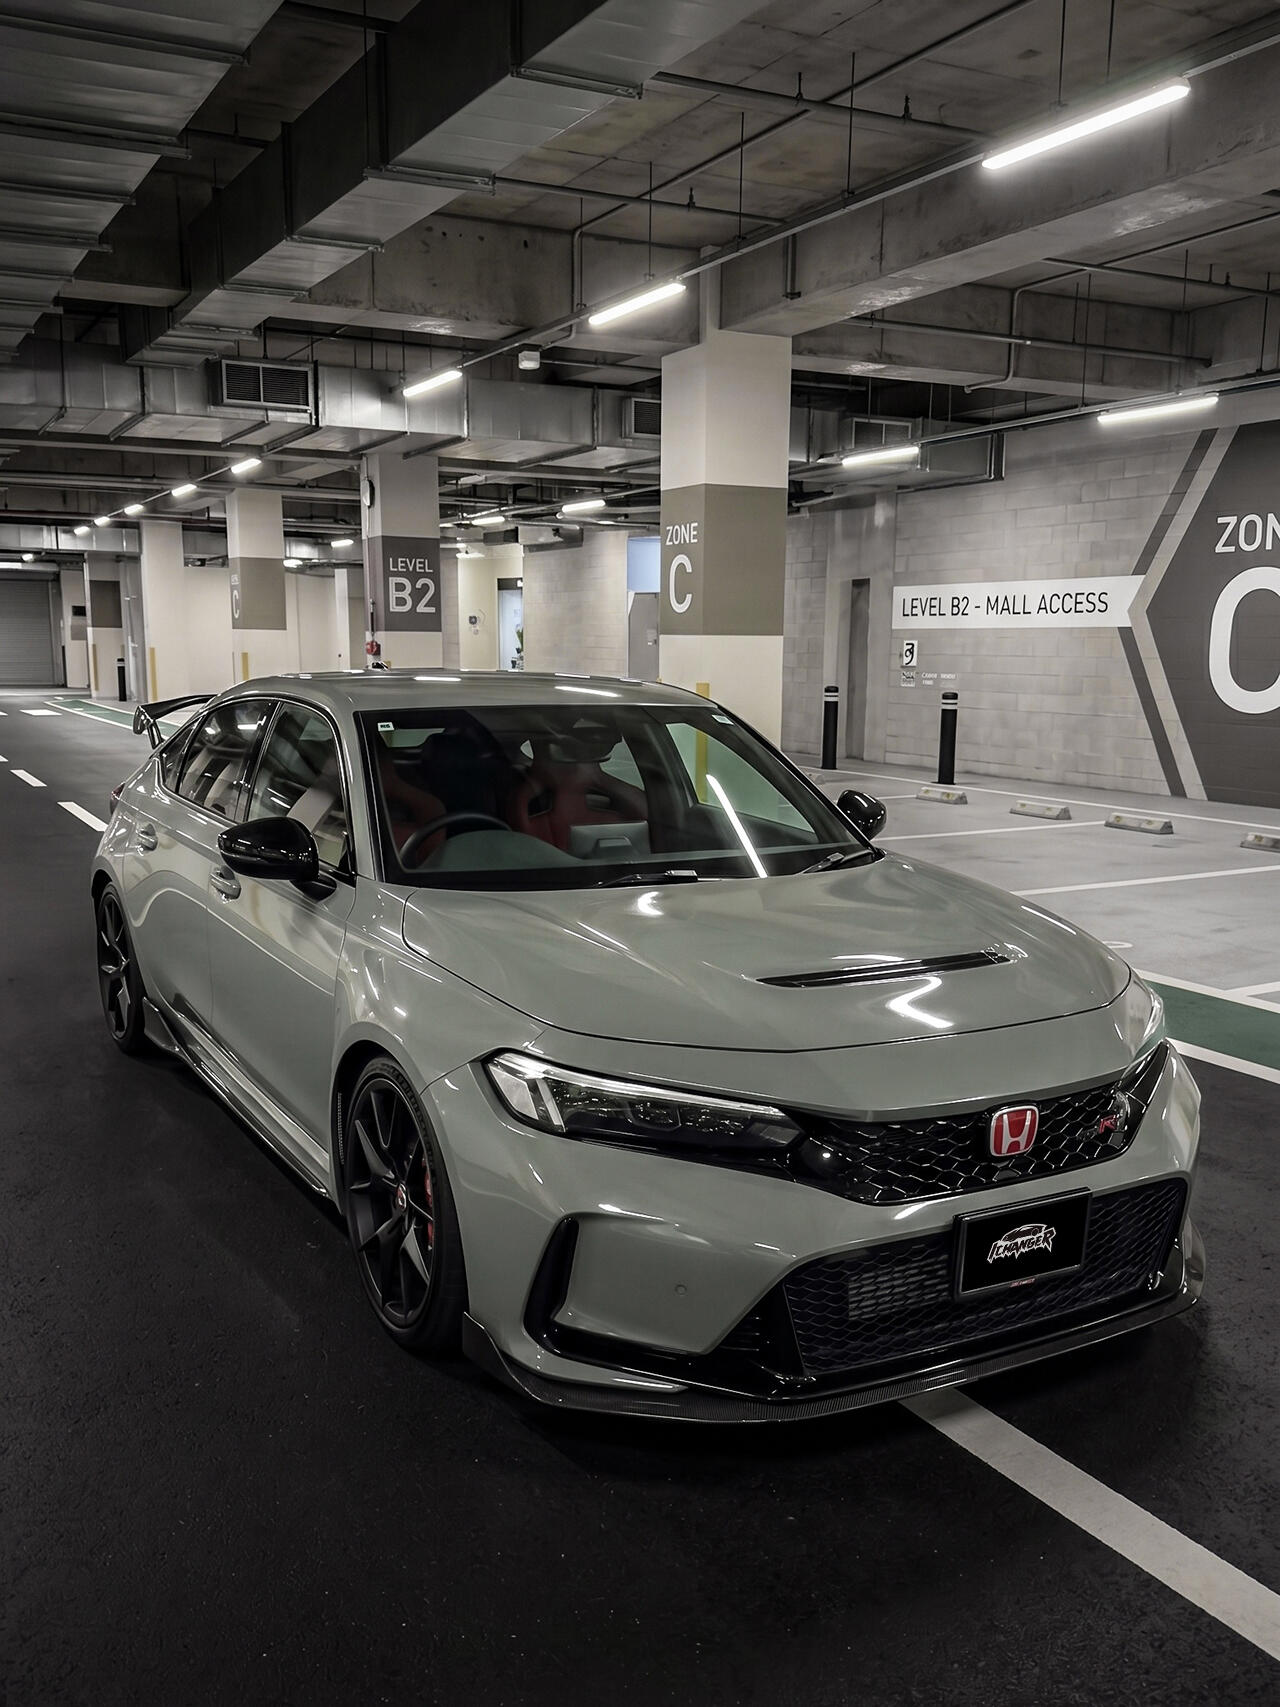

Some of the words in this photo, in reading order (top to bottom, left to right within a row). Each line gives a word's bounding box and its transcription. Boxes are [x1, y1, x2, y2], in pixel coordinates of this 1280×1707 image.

[666, 523, 698, 545] ZONE
[389, 558, 434, 572] LEVEL
[389, 577, 436, 613] B2
[670, 554, 692, 613] C
[232, 590, 240, 618] C
[902, 597, 946, 616] LEVEL
[951, 596, 970, 615] B2
[986, 595, 1031, 615] MALL
[1037, 592, 1109, 614] ACCESS
